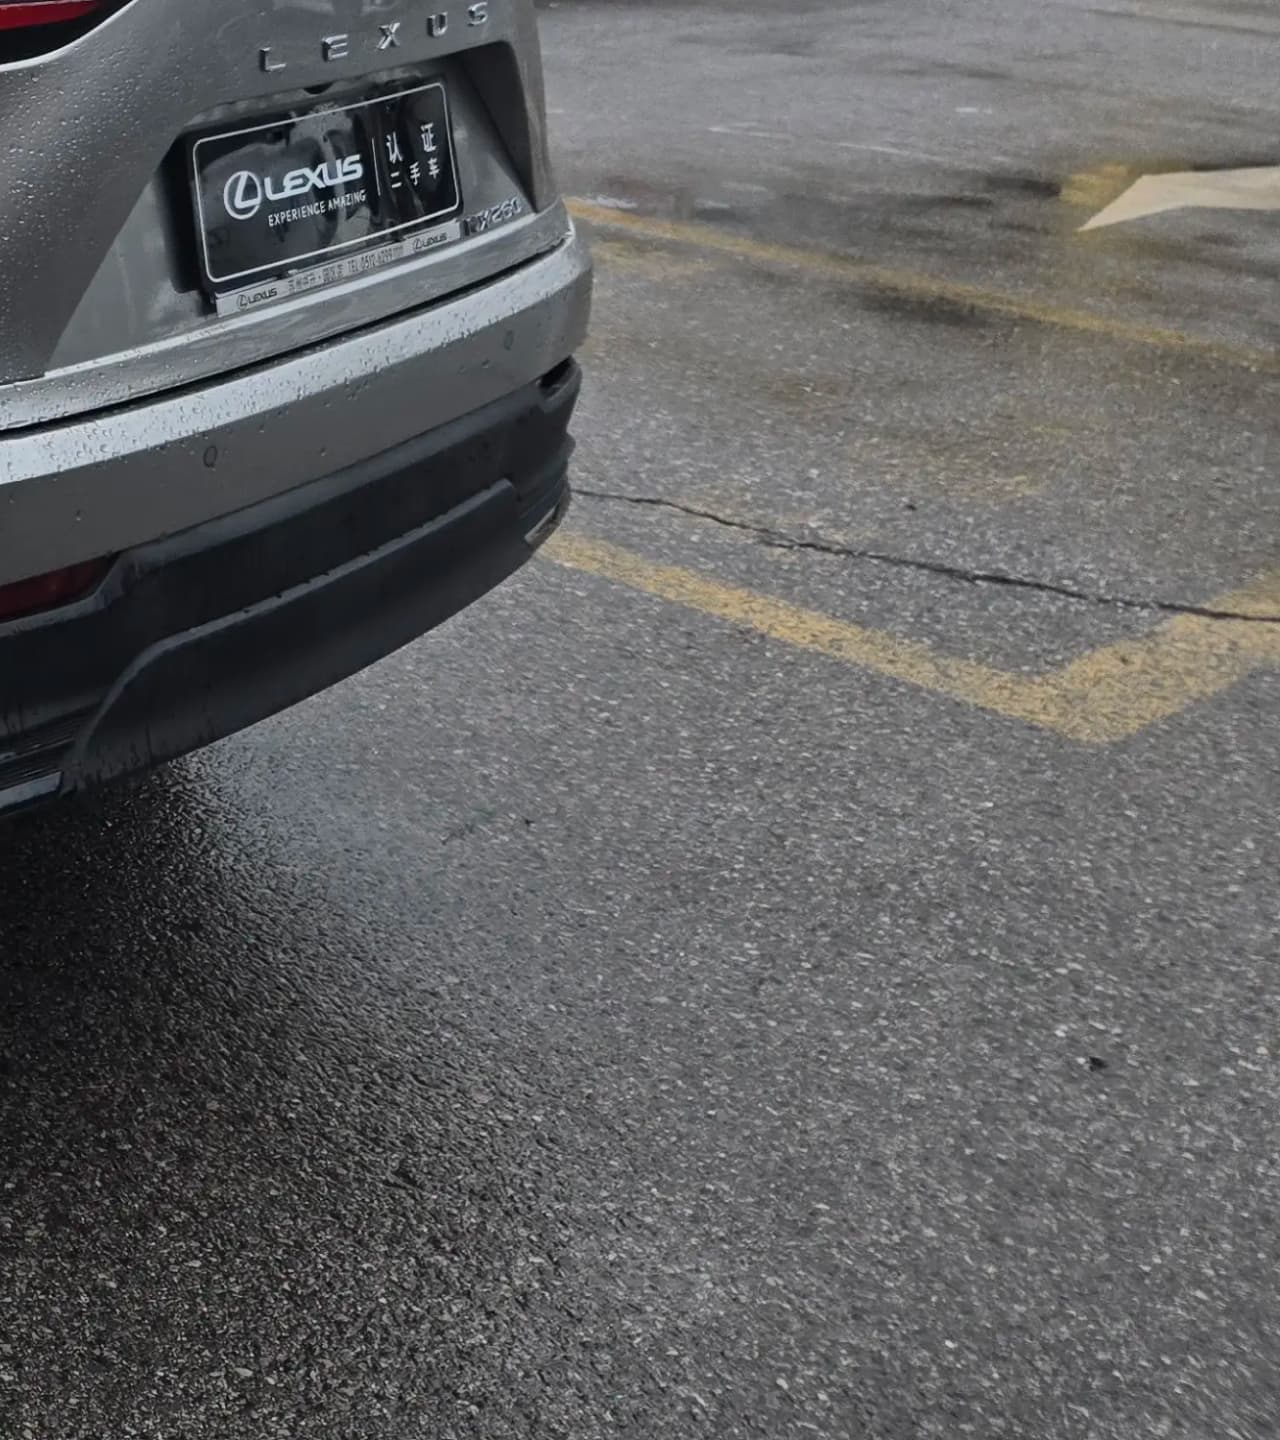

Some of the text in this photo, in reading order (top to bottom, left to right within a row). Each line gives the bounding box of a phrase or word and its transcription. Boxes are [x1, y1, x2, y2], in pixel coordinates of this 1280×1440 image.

[258, 1, 489, 72] LEXUS
[386, 122, 437, 165] 认证
[264, 154, 364, 201] LEXUS
[390, 157, 440, 189] 二手车
[268, 189, 367, 227] EXPERIENCE AMAZING
[248, 287, 278, 305] LEXUS
